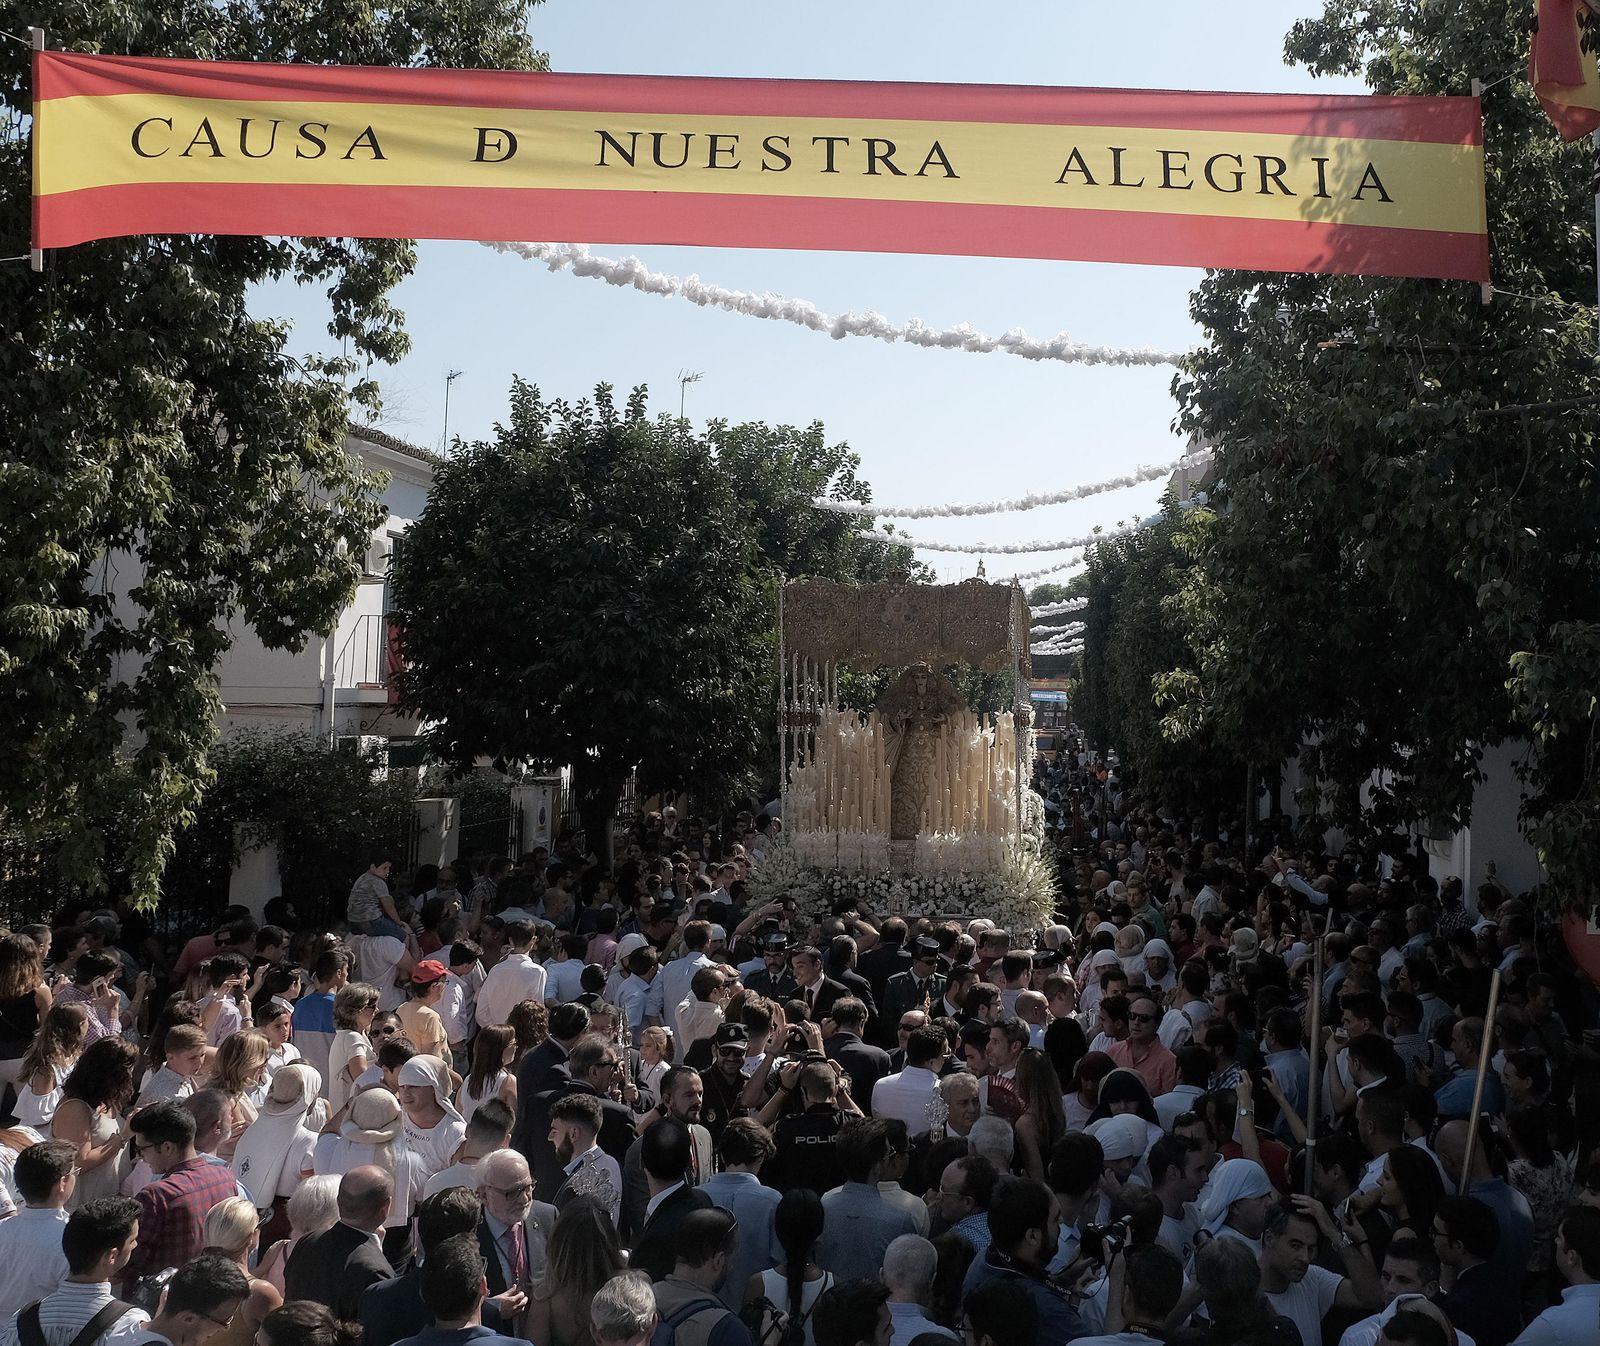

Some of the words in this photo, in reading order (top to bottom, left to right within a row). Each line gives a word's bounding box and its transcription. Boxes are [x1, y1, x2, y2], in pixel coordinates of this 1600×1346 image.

[131, 116, 387, 160] CAUSA
[594, 130, 961, 178] NUESTRA
[1054, 146, 1395, 203] ALEGRIA
